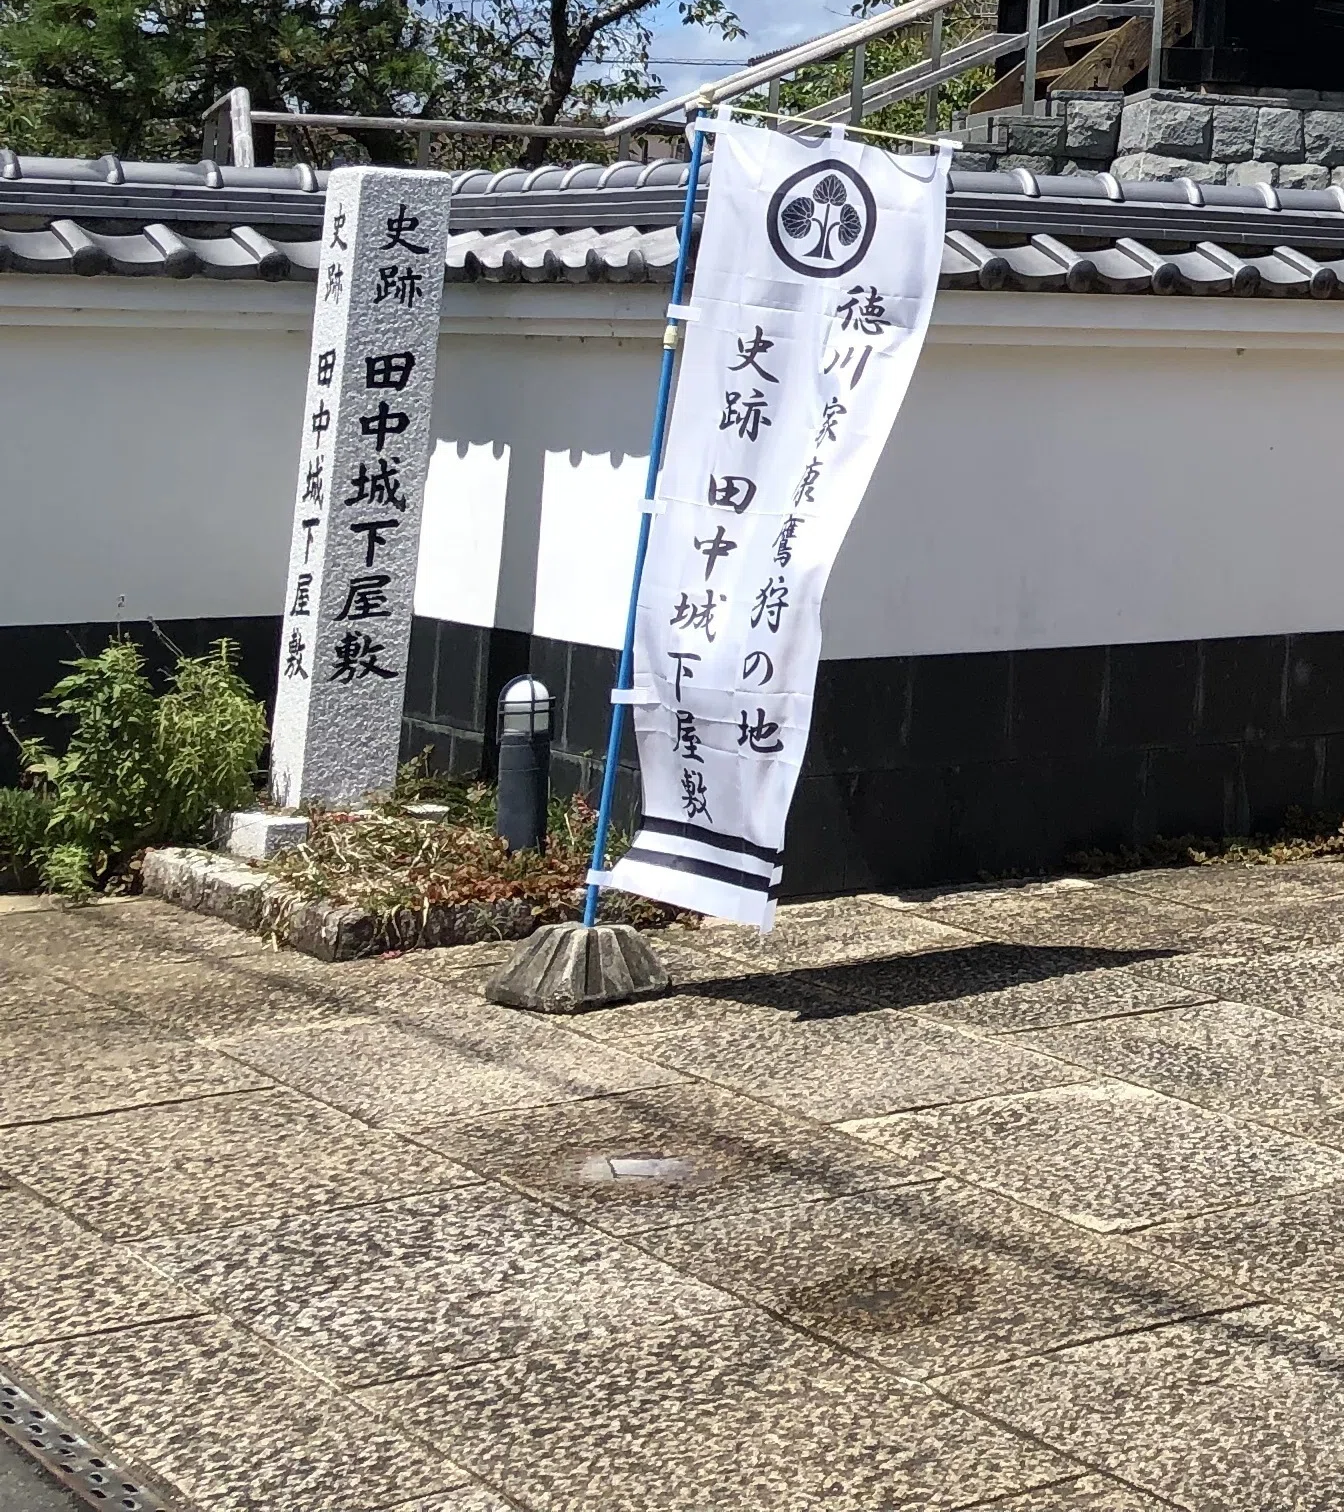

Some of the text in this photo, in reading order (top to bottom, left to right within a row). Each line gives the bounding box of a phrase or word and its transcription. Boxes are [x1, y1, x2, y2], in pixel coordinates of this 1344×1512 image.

[284, 203, 348, 682] 史跡 田中城下屋敷
[329, 204, 429, 684] 史跡 田中城下屋敷
[668, 325, 780, 824] 史跡 田中城下屋敷
